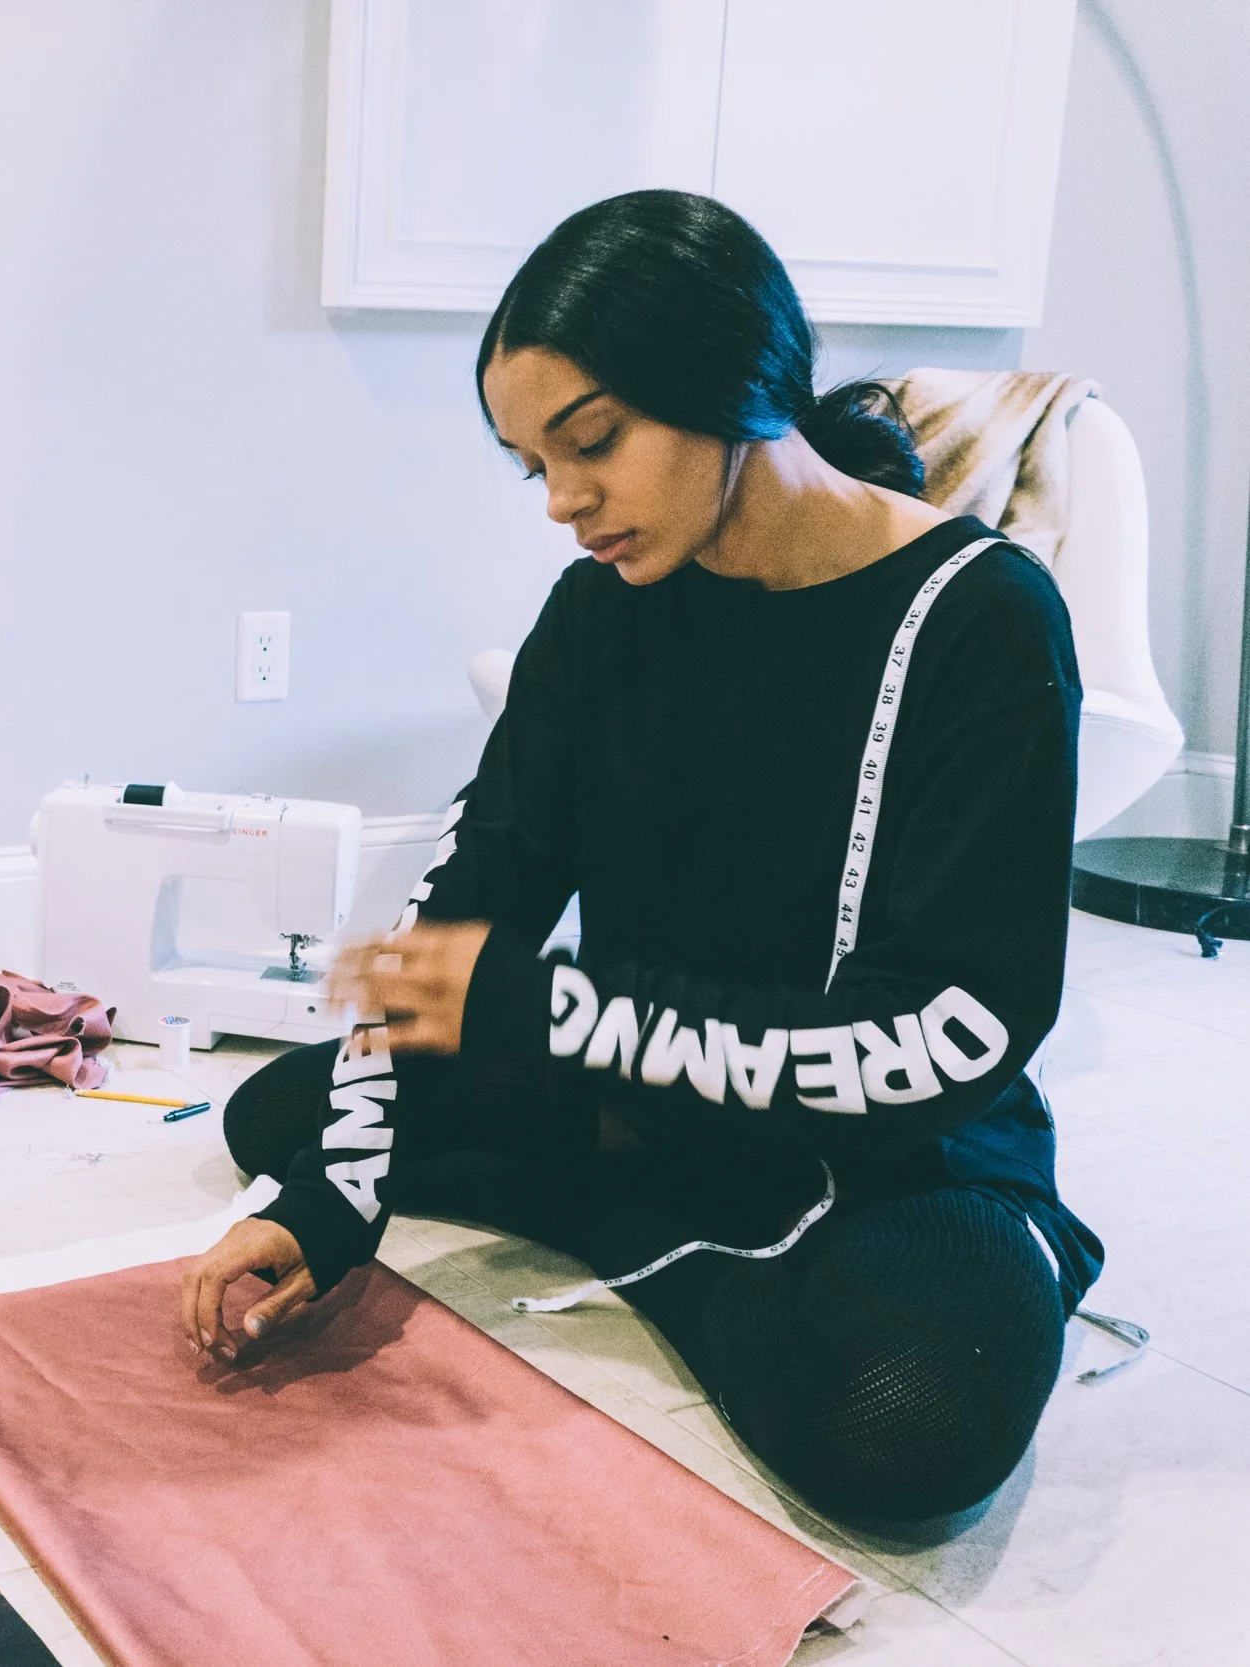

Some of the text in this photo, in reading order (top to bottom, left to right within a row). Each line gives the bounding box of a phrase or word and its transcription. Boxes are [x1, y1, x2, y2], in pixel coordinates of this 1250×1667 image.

[950, 552, 971, 566] 34
[923, 576, 943, 594] 35
[904, 609, 921, 629] 36
[891, 645, 905, 667] 37
[882, 684, 896, 705] 38
[872, 721, 887, 743] 39
[863, 759, 878, 780] 40
[858, 795, 873, 816] 41
[231, 829, 268, 837] SINGER
[852, 832, 867, 853] 42
[845, 868, 859, 888] 43
[841, 903, 853, 923] 44
[836, 938, 848, 957] 45
[550, 963, 1009, 1114] DREAMNG
